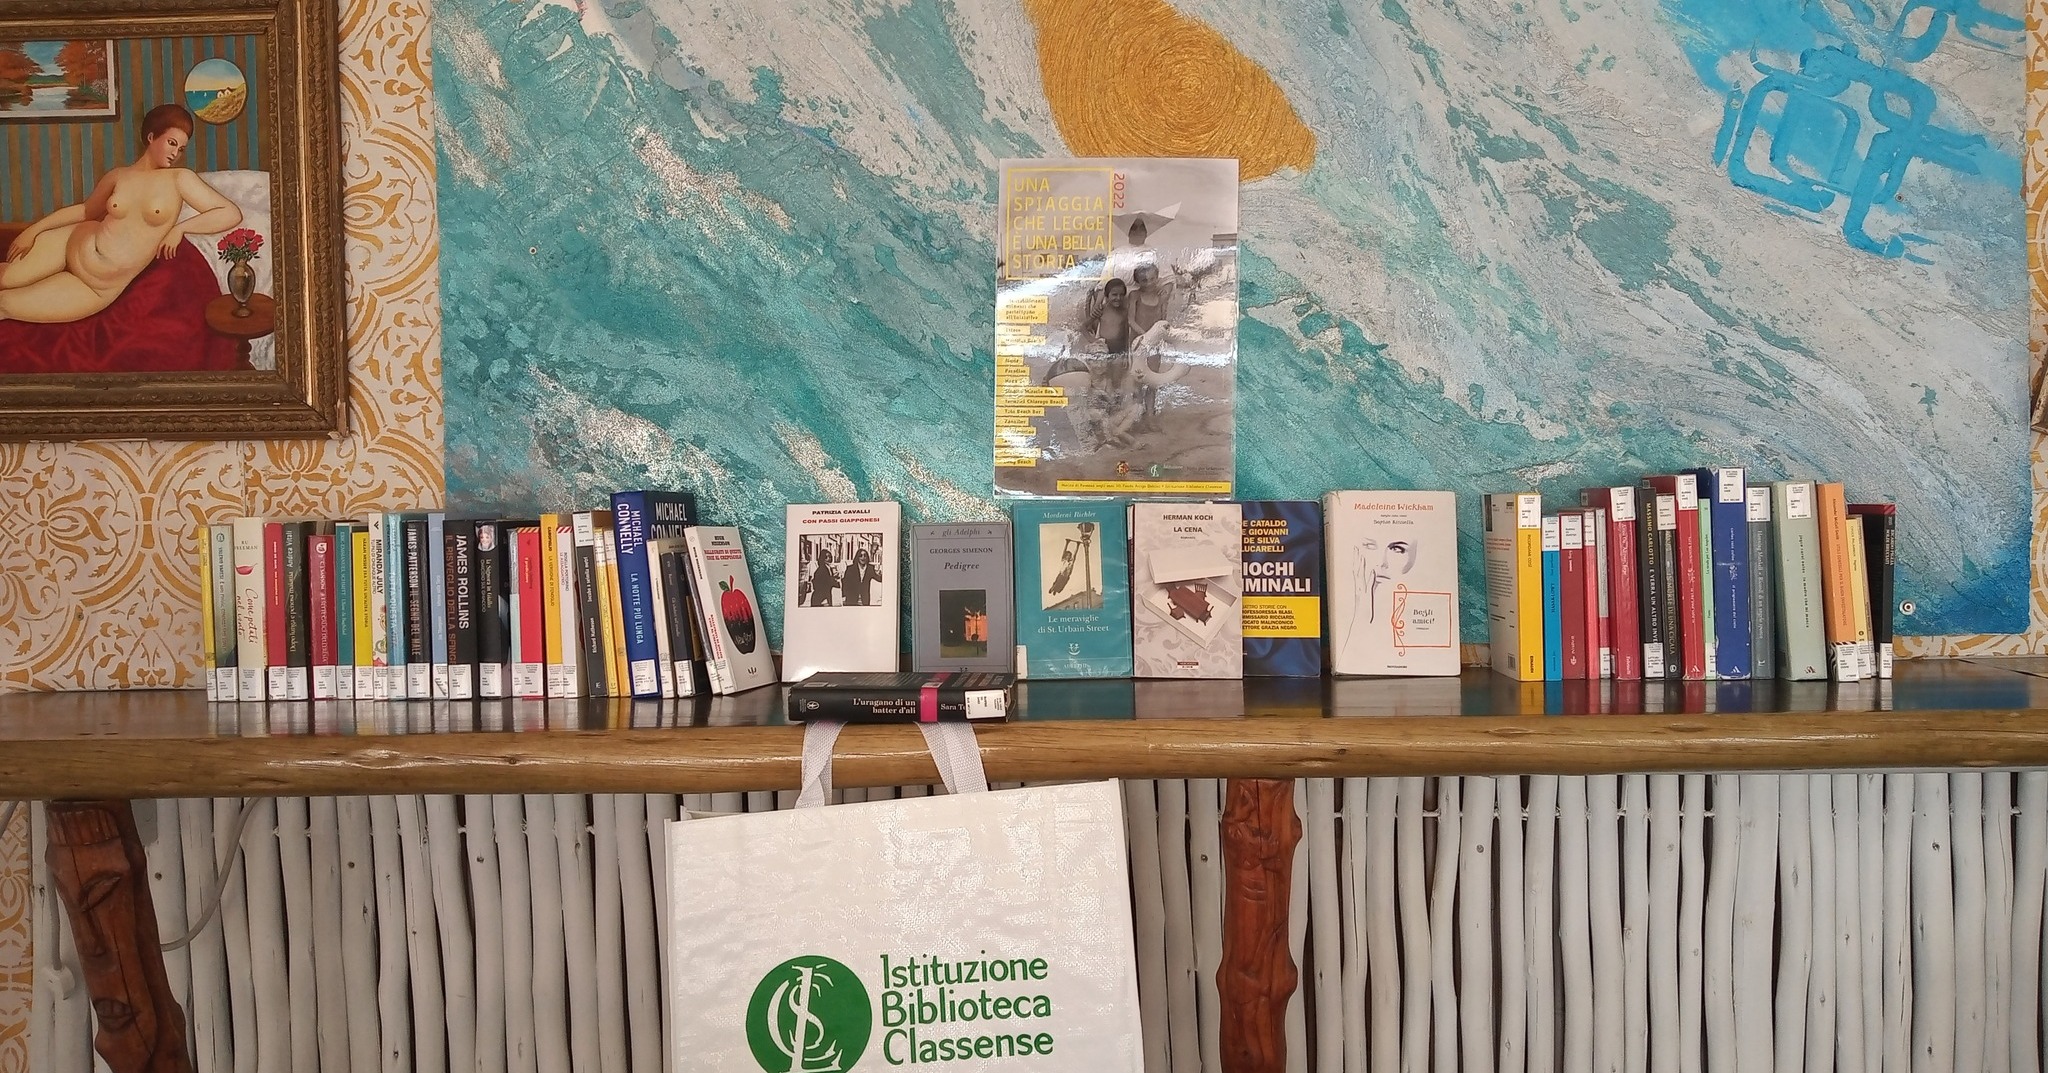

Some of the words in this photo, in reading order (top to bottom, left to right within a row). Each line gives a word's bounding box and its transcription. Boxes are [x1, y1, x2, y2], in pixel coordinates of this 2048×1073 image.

[1014, 177, 1050, 192] UNA
[1113, 173, 1125, 209] 2022
[1013, 197, 1104, 212] SPIAGGIA
[1013, 216, 1044, 231] CHE
[1053, 216, 1104, 231] LEGGE
[1025, 235, 1056, 250] UNA
[1062, 235, 1105, 250] BELLA
[1012, 254, 1076, 270] STORIA
[656, 502, 688, 521] MICHAEL
[1354, 502, 1396, 510] Madeleine
[1397, 503, 1434, 511] Wickham
[616, 503, 633, 554] CONNELLY
[630, 510, 643, 547] MICHAEL
[650, 524, 694, 539] CONNE
[955, 528, 980, 538] Adelphi
[406, 528, 416, 549] JAMES
[445, 535, 452, 543] IL
[456, 534, 468, 574] JAMES
[408, 552, 418, 588] PATTERSON
[446, 546, 454, 596] RISVEGLIO
[944, 562, 980, 572] Pedigree
[1242, 562, 1294, 576] IOCHI
[630, 574, 638, 582] LA
[1242, 578, 1311, 592] MINALI
[632, 584, 640, 606] NOTTE
[1651, 596, 1656, 605] UN
[410, 600, 419, 621] SEGNO
[458, 578, 469, 629] ROLLINS
[448, 600, 456, 630] DELLA
[633, 608, 643, 620] PIÙ
[1060, 614, 1100, 624] meraviglie
[411, 623, 420, 636] DEL
[635, 621, 644, 644] LUNGA
[411, 638, 420, 656] MALE
[853, 698, 894, 708] L'uragano
[895, 698, 904, 706] di
[872, 706, 898, 714] batter
[898, 706, 916, 714] d'ali
[880, 950, 1048, 989] Istituzione
[882, 986, 1052, 1028] Biblioteca
[882, 1027, 1054, 1066] Classense
